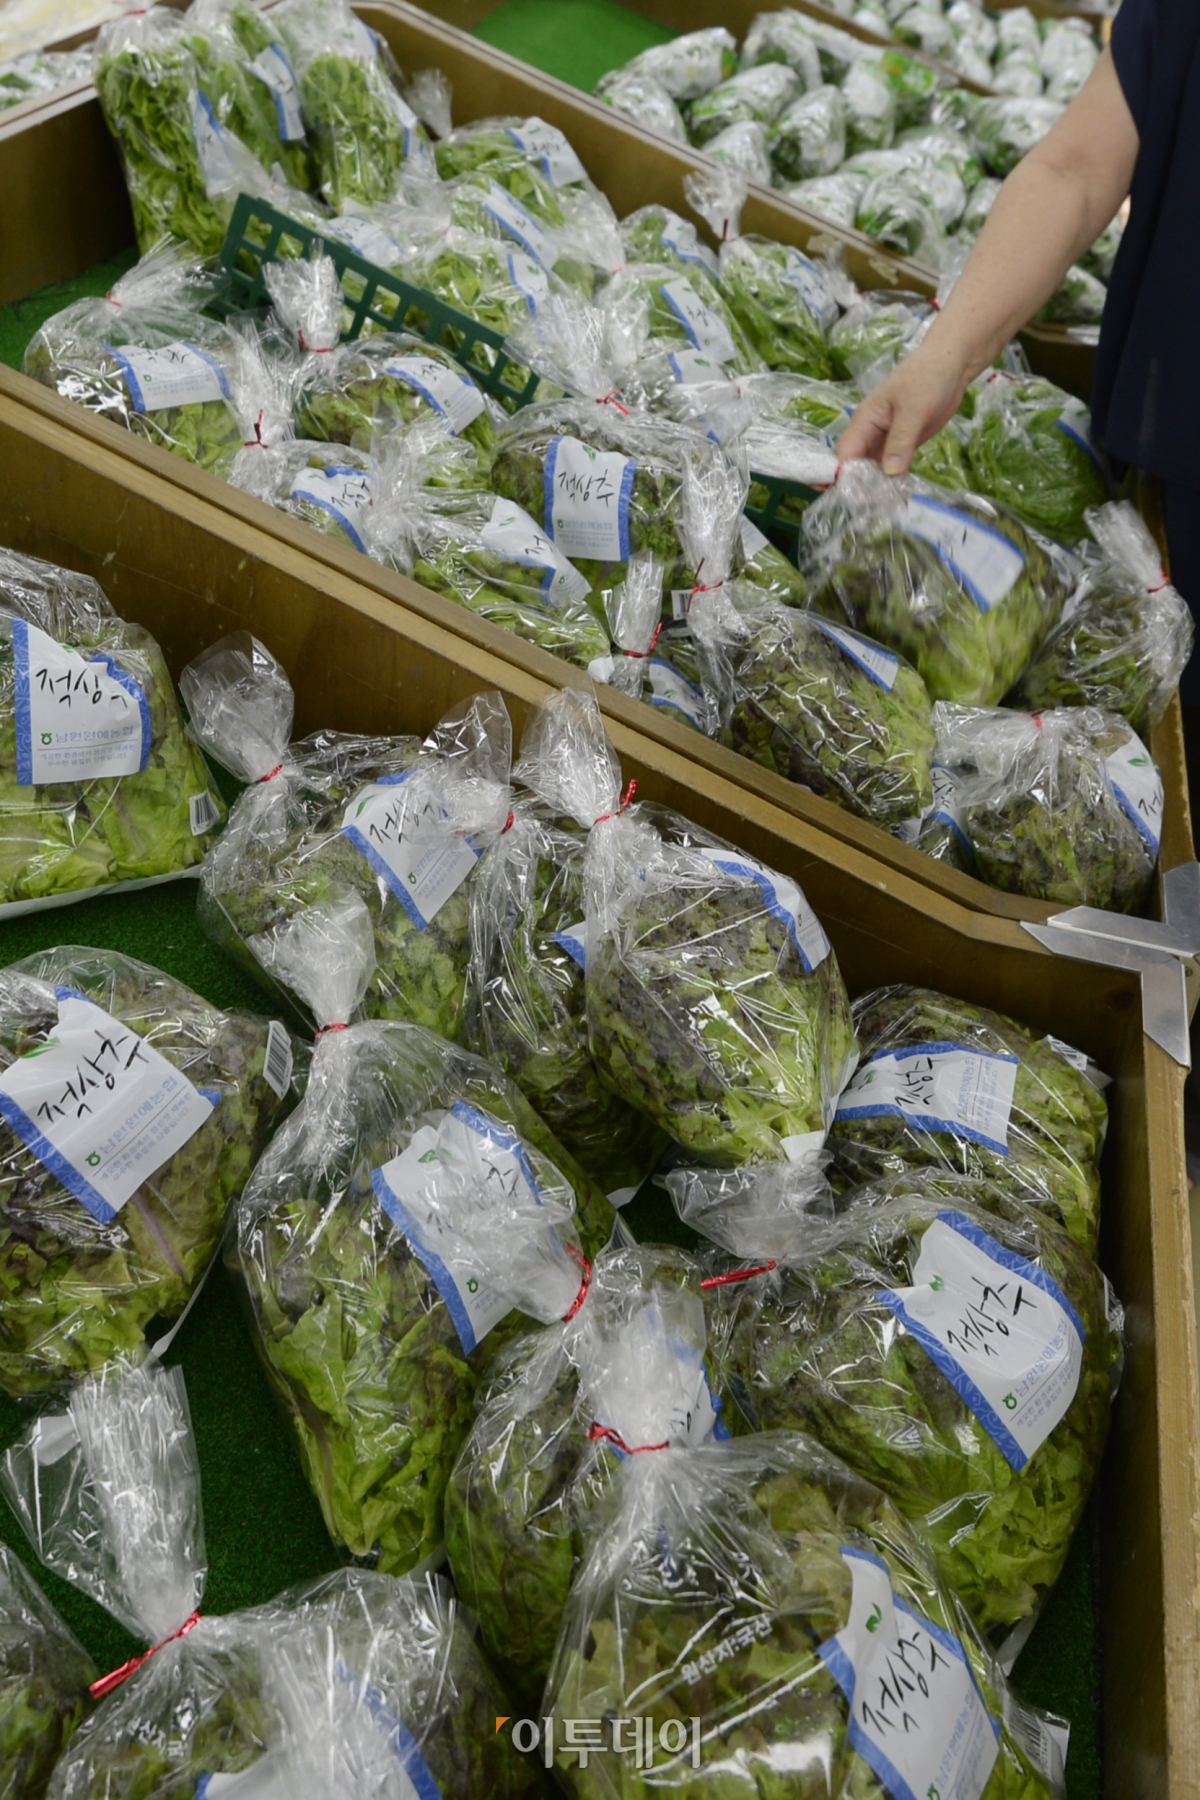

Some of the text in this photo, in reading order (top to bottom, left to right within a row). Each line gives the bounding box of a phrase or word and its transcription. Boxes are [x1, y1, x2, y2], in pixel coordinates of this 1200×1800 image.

[558, 469, 615, 508] 적상추
[37, 1029, 150, 1123] 적상추
[98, 1075, 179, 1156] 남원원예농협
[946, 1276, 1038, 1357] 적상추
[681, 1613, 773, 1686] 원산지:국산
[861, 1632, 951, 1737] 적상추
